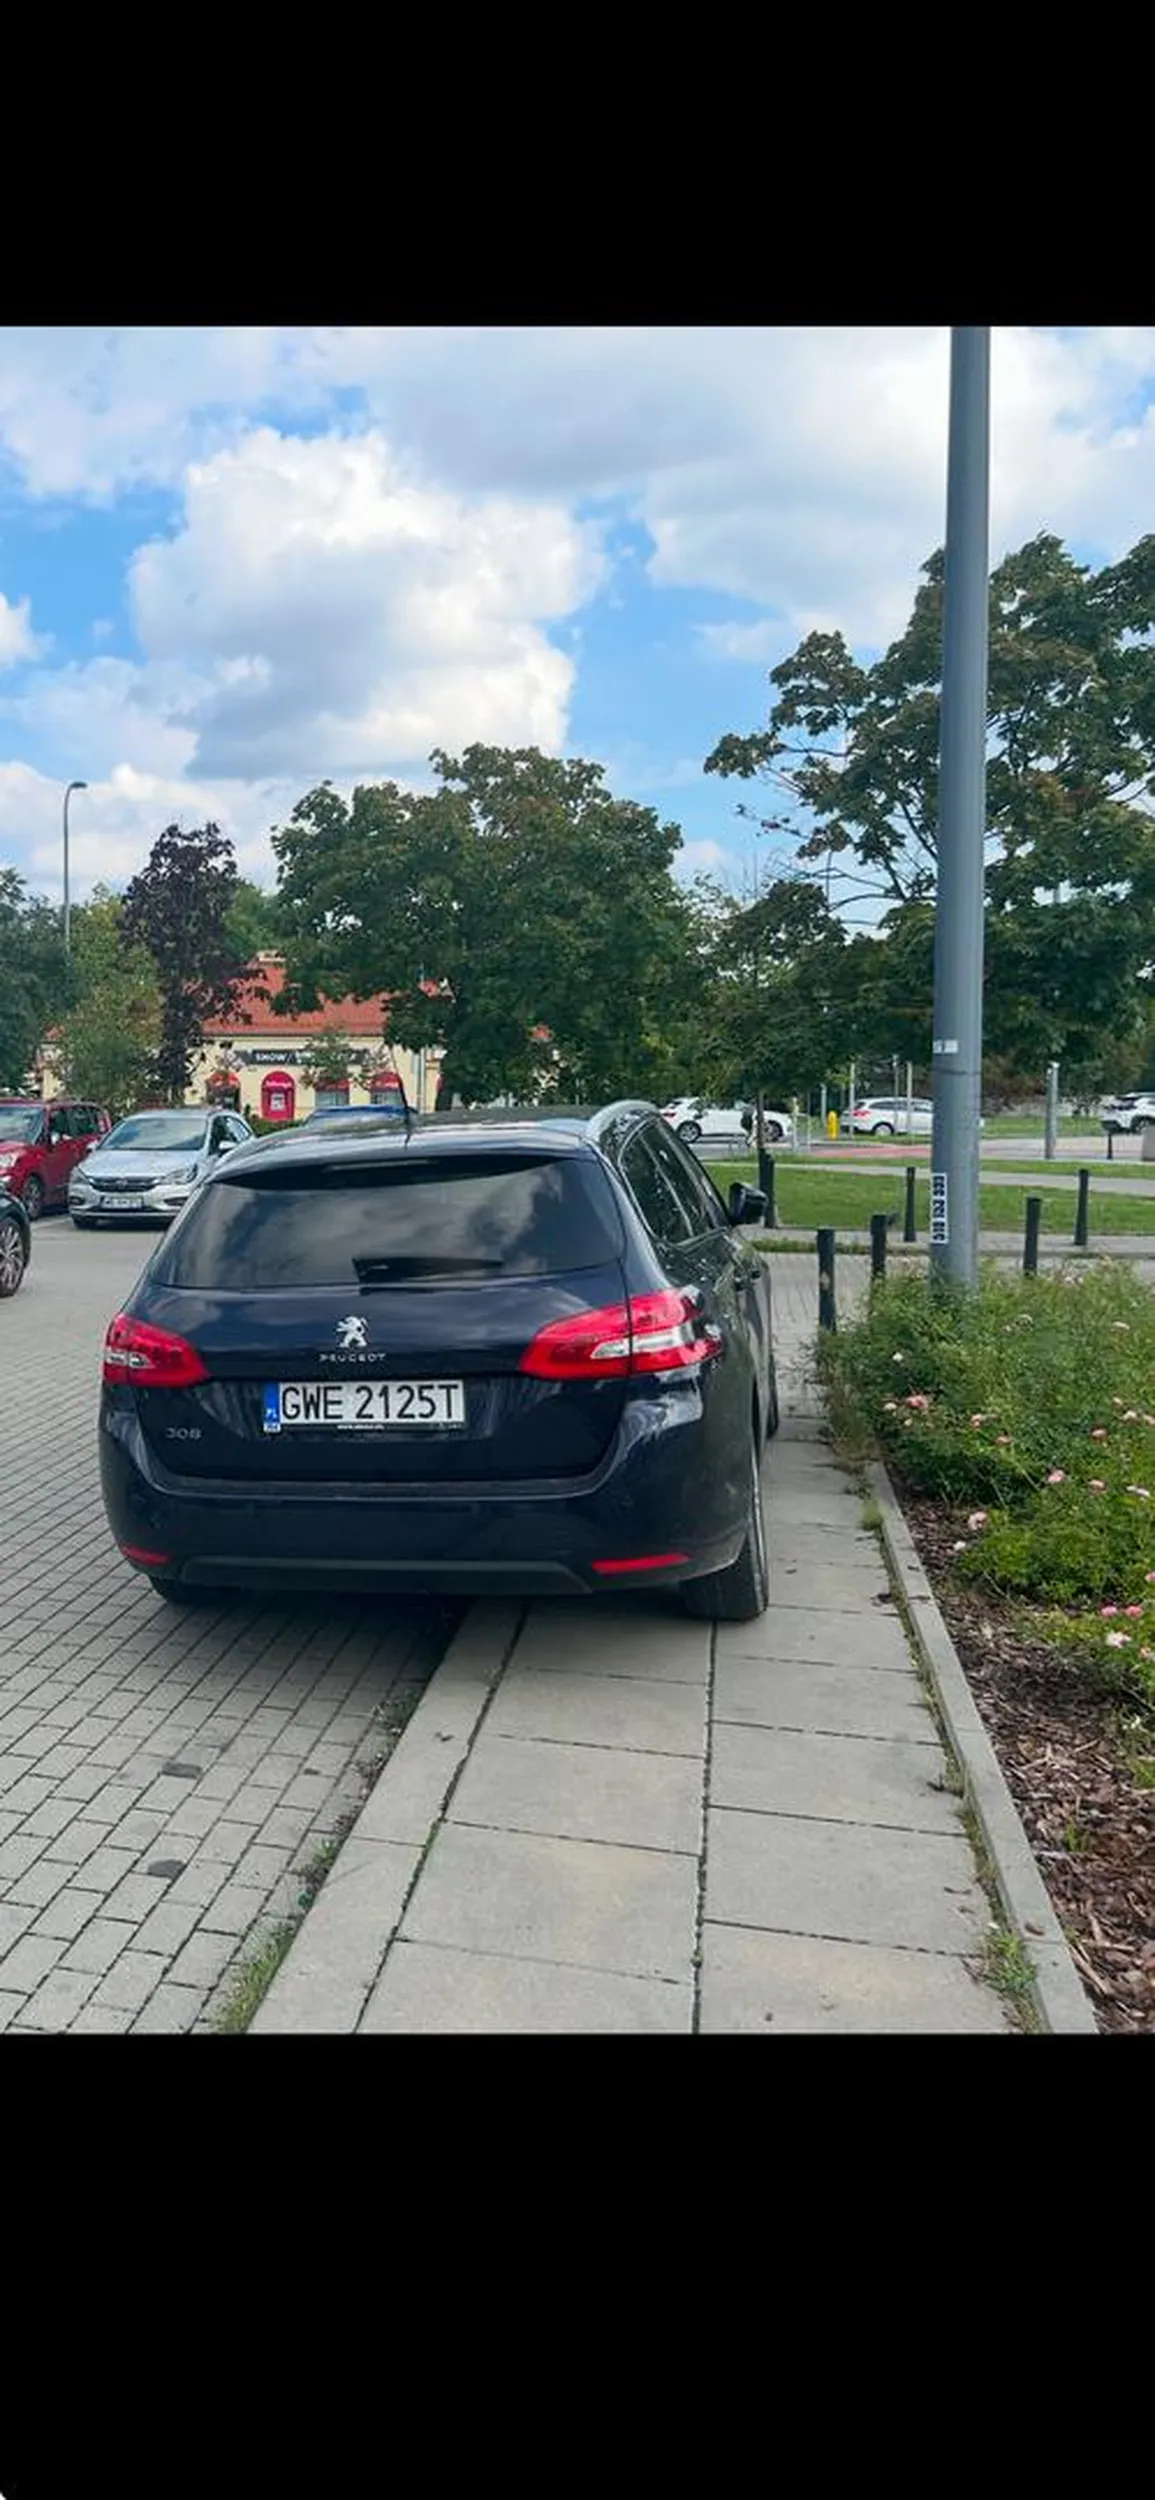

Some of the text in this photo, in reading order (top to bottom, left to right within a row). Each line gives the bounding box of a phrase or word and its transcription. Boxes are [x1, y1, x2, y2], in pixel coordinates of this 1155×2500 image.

[319, 1353, 386, 1362] PEUGEOT
[282, 1384, 459, 1419] GWE 2125T
